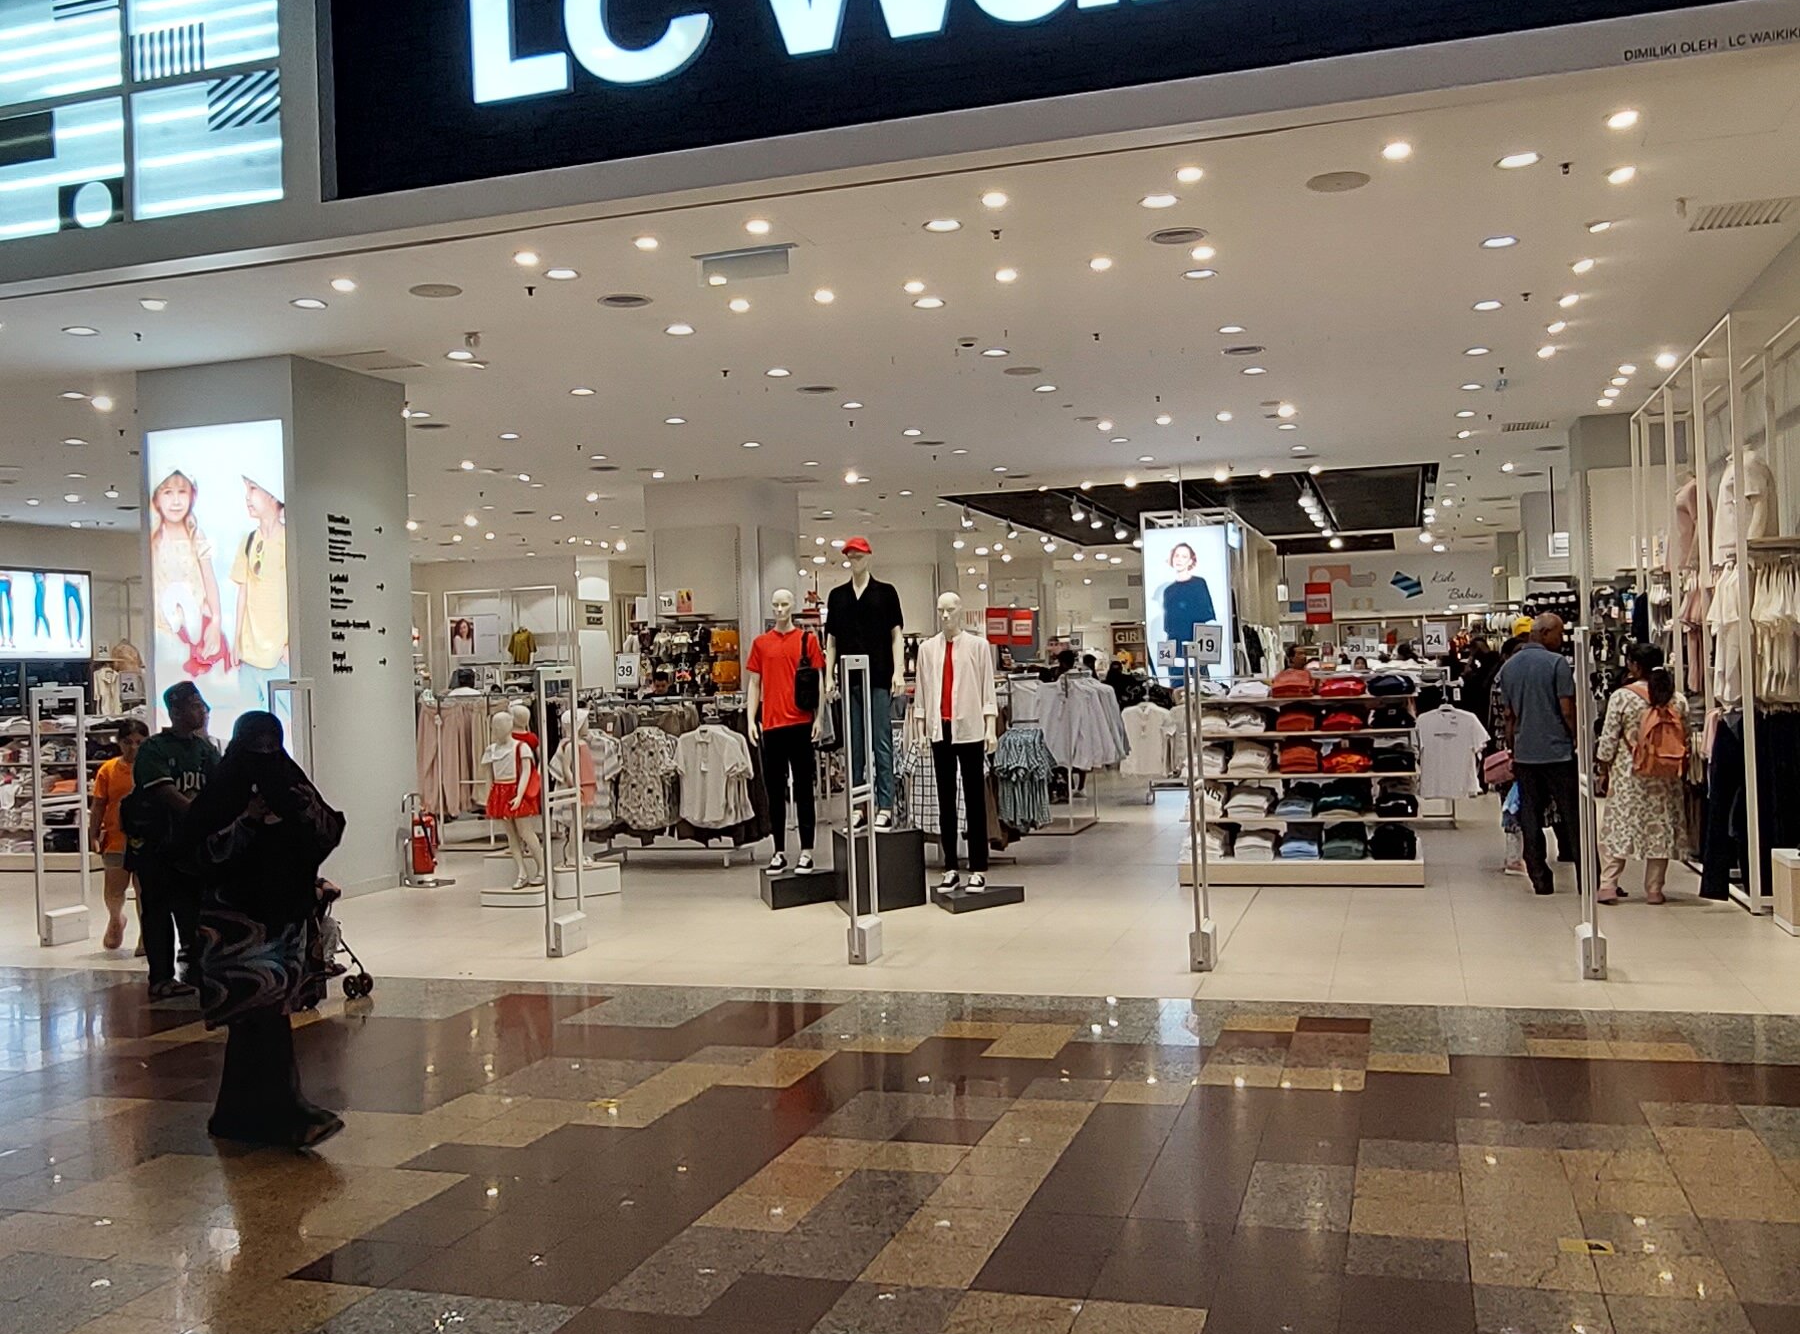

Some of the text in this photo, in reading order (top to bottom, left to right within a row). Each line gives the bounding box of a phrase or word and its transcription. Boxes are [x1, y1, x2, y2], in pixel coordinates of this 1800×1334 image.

[1623, 42, 1677, 62] DIMILIKI
[1680, 38, 1718, 54] OLEH
[1728, 33, 1747, 48] LC
[1430, 571, 1456, 584] Kids
[1448, 588, 1483, 600] Babies
[1199, 638, 1215, 653] 19
[1426, 634, 1441, 646] 24
[618, 665, 633, 677] 39
[122, 682, 134, 693] 24
